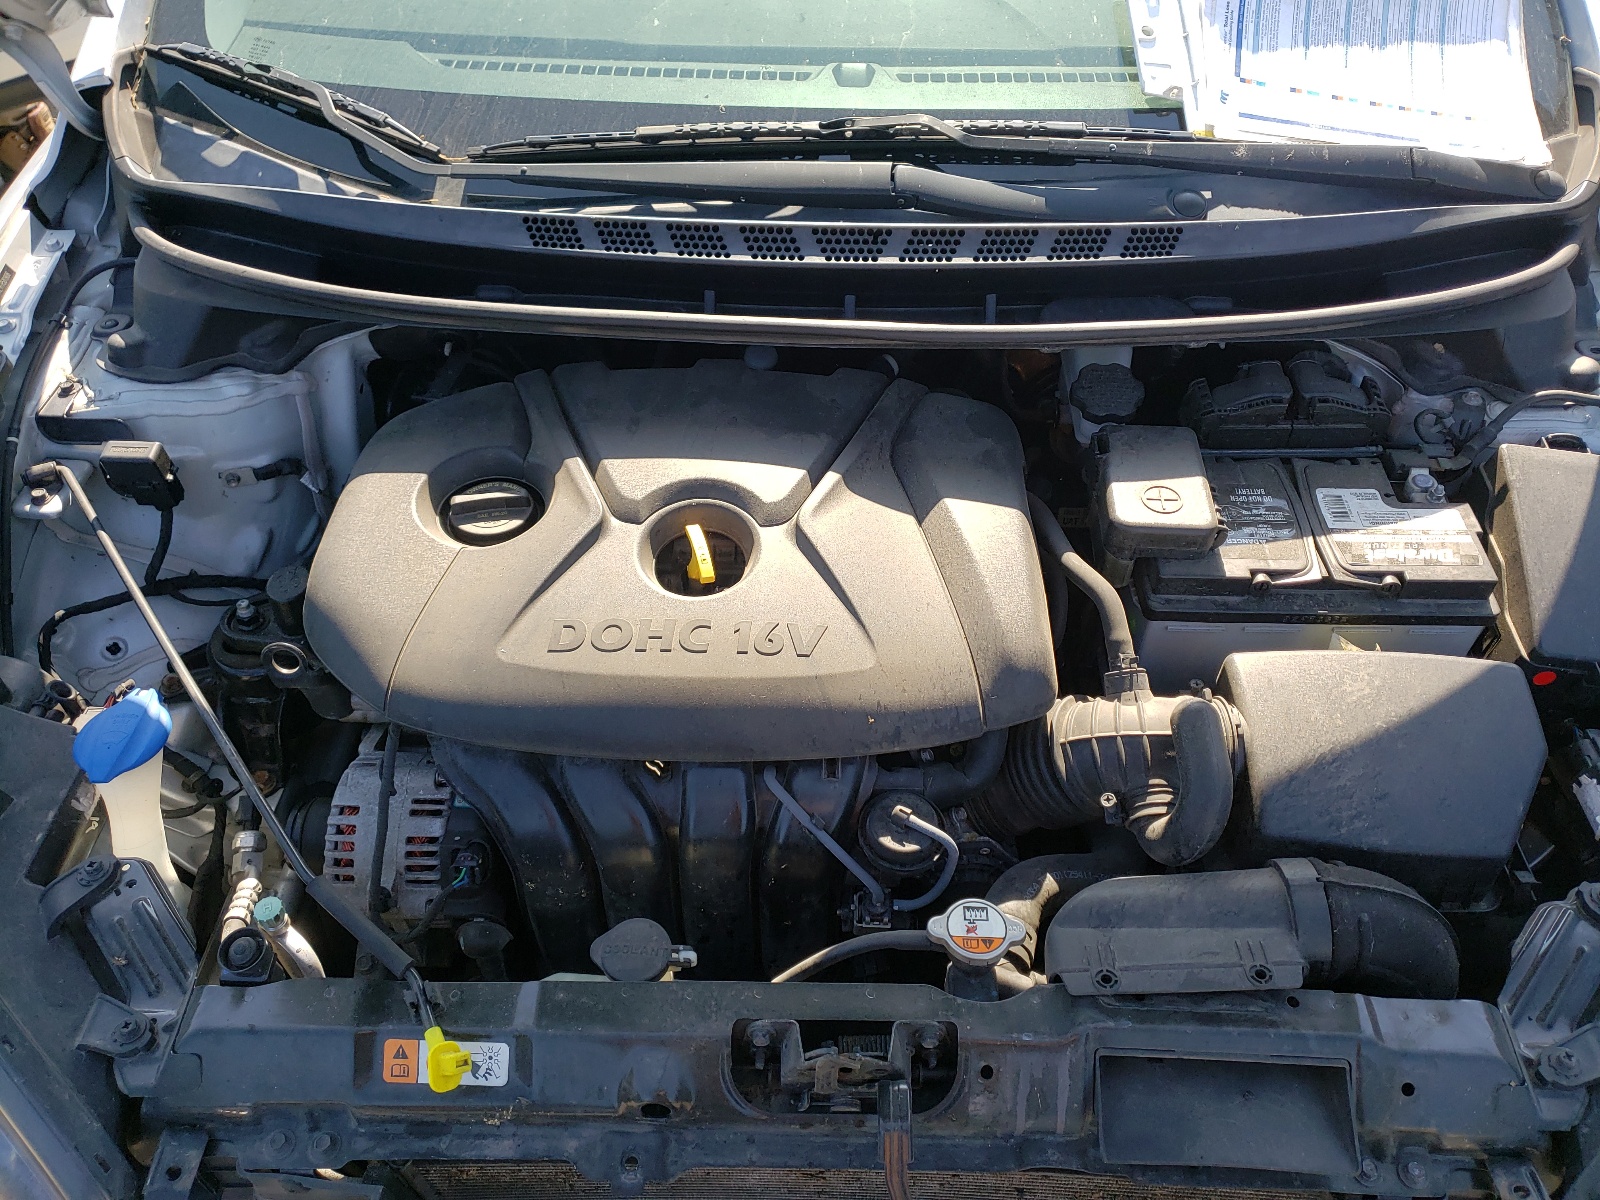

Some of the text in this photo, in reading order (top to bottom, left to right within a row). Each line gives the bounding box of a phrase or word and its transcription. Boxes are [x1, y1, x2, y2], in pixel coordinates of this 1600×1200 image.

[1249, 495, 1262, 503] NOT
[1262, 495, 1272, 503] DO
[1364, 548, 1454, 564] Duralast
[546, 617, 829, 658] DOHC 16V
[262, 901, 273, 914] H
[603, 943, 669, 957] COOLANT
